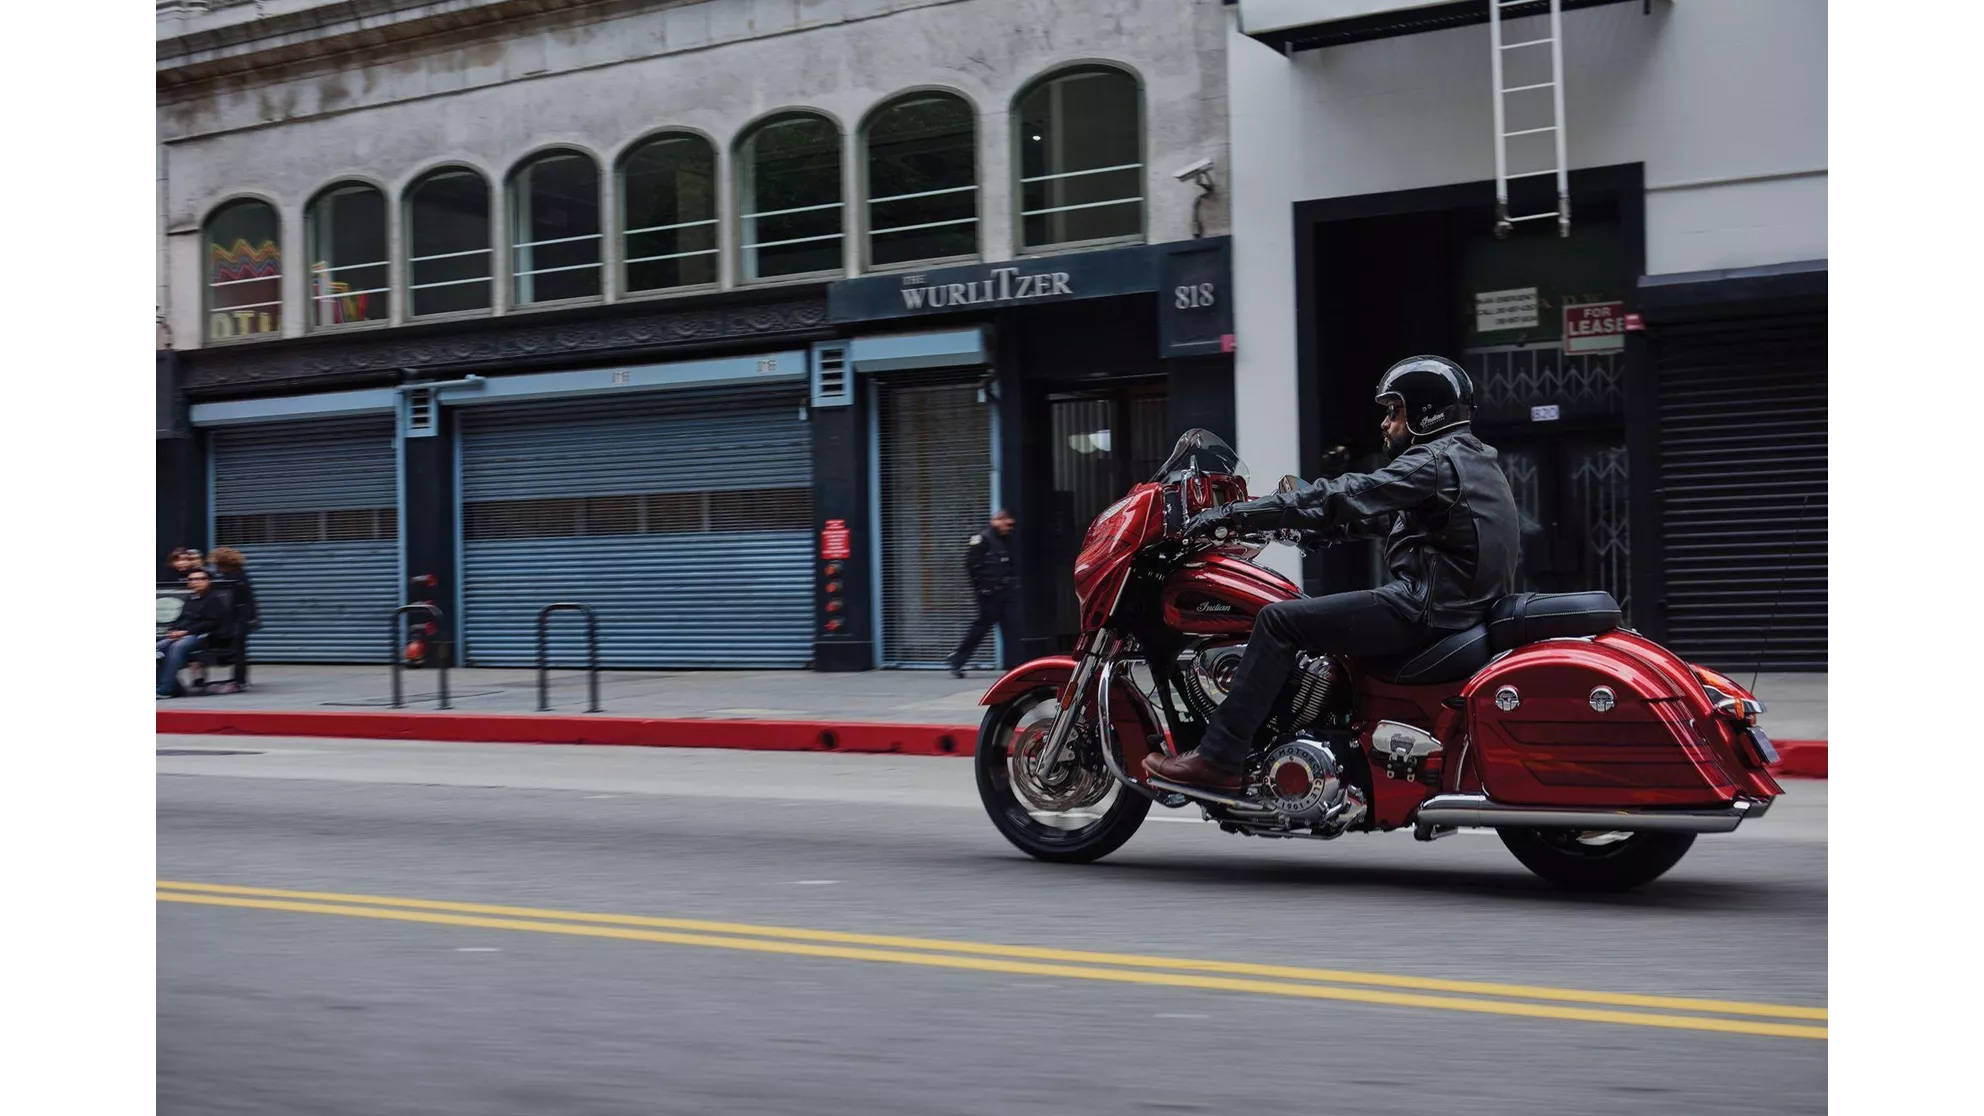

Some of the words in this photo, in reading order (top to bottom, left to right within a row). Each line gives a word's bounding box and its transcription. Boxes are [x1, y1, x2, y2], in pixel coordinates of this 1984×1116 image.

[901, 267, 1074, 310] WURLITZER
[1174, 283, 1215, 309] 818
[1583, 306, 1612, 318] FOR
[1568, 317, 1624, 335] LEASE
[1196, 601, 1231, 612] Indian
